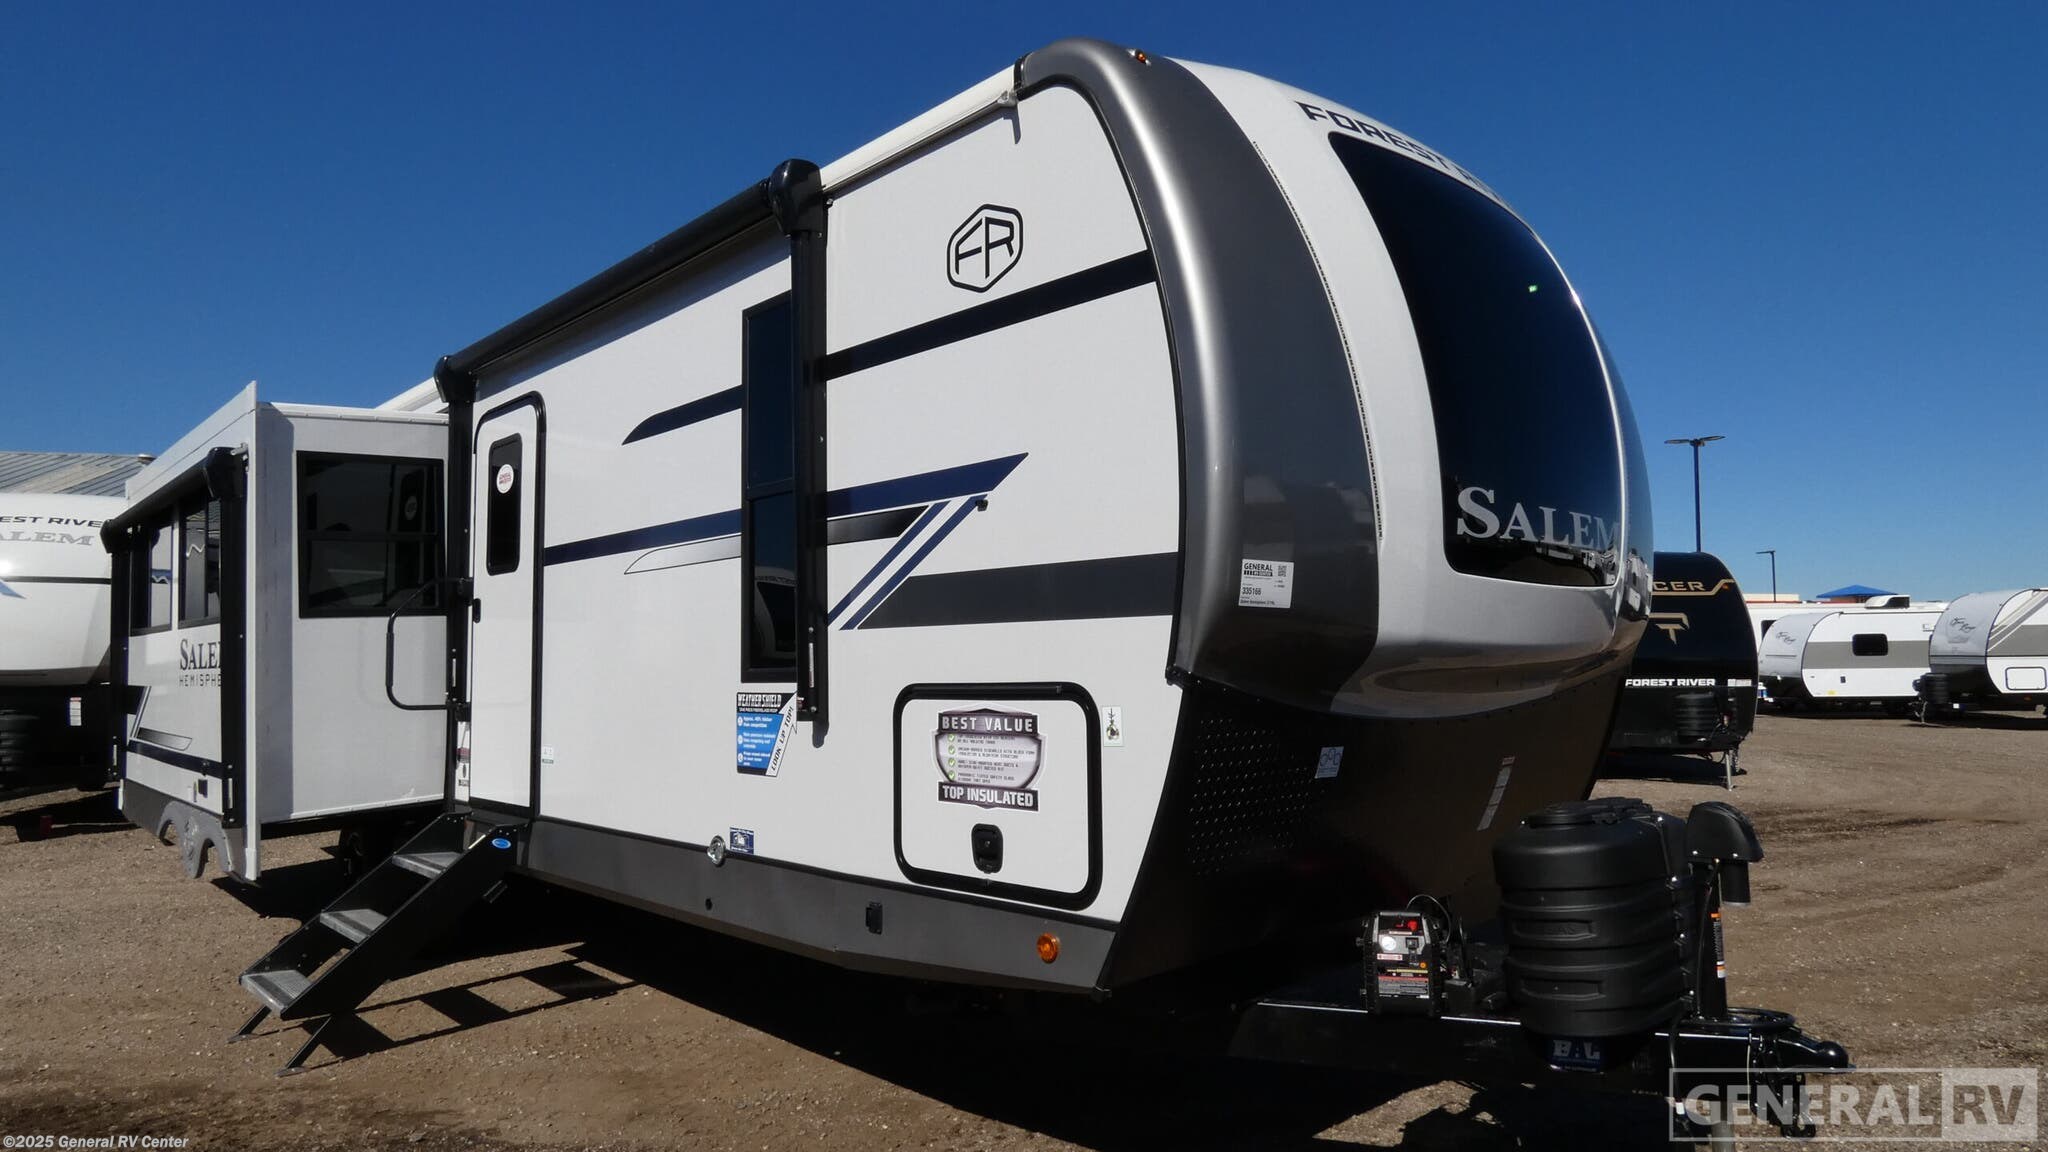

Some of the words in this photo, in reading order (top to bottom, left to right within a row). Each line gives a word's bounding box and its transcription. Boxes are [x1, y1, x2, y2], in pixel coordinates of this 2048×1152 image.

[1296, 100, 1450, 170] FOREST
[1456, 486, 1621, 550] SALEM
[1244, 563, 1273, 571] GENERAL
[180, 638, 221, 670] SALE
[942, 716, 977, 730] BEST
[984, 717, 1033, 732] VALUE
[771, 748, 782, 772] LOOK
[779, 730, 786, 744] UP
[942, 785, 964, 800] TOP
[966, 787, 1034, 807] INSULATED
